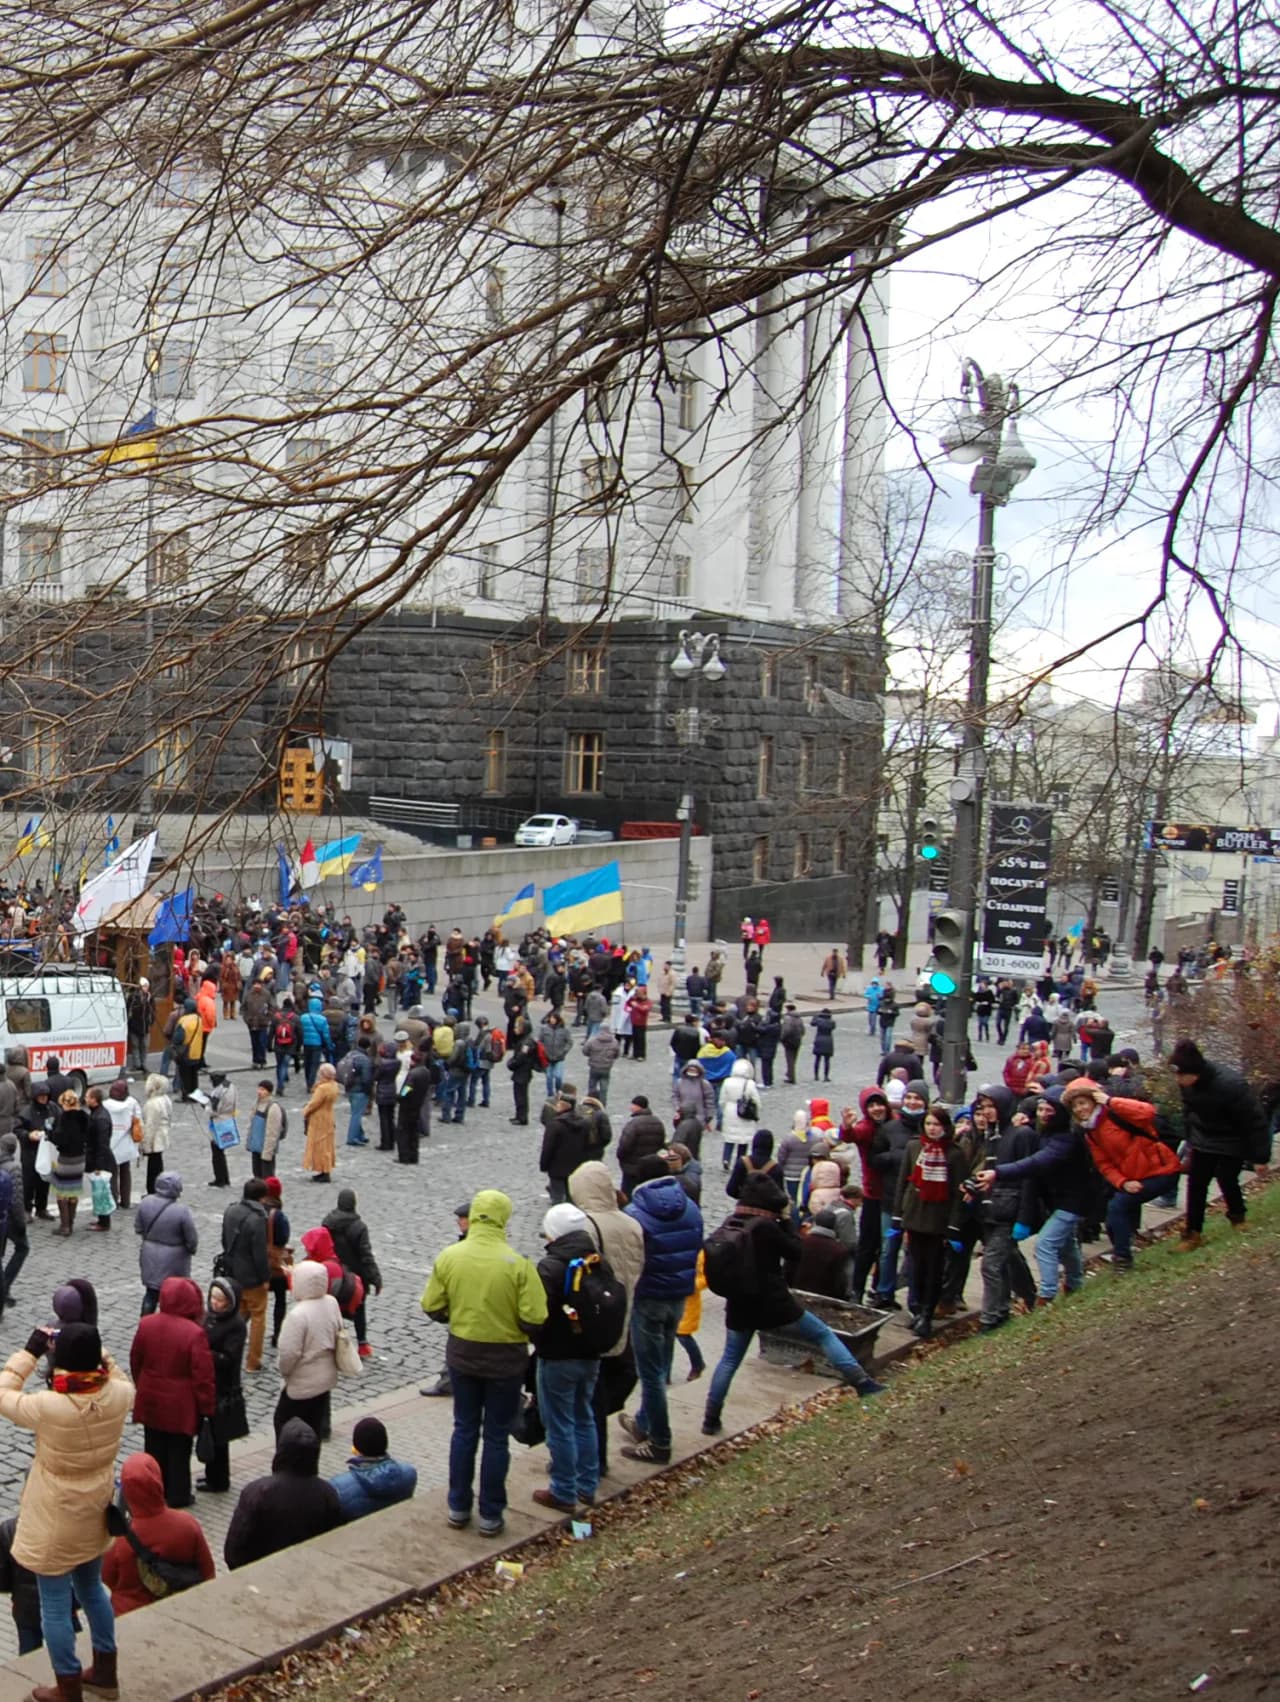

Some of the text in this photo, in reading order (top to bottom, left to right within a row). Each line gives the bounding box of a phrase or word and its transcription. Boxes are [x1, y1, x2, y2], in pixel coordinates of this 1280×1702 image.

[1216, 838, 1269, 850] BUTLER
[998, 920, 1032, 930] шосе
[1005, 935, 1023, 946] 90
[985, 957, 1041, 970] 201-6000
